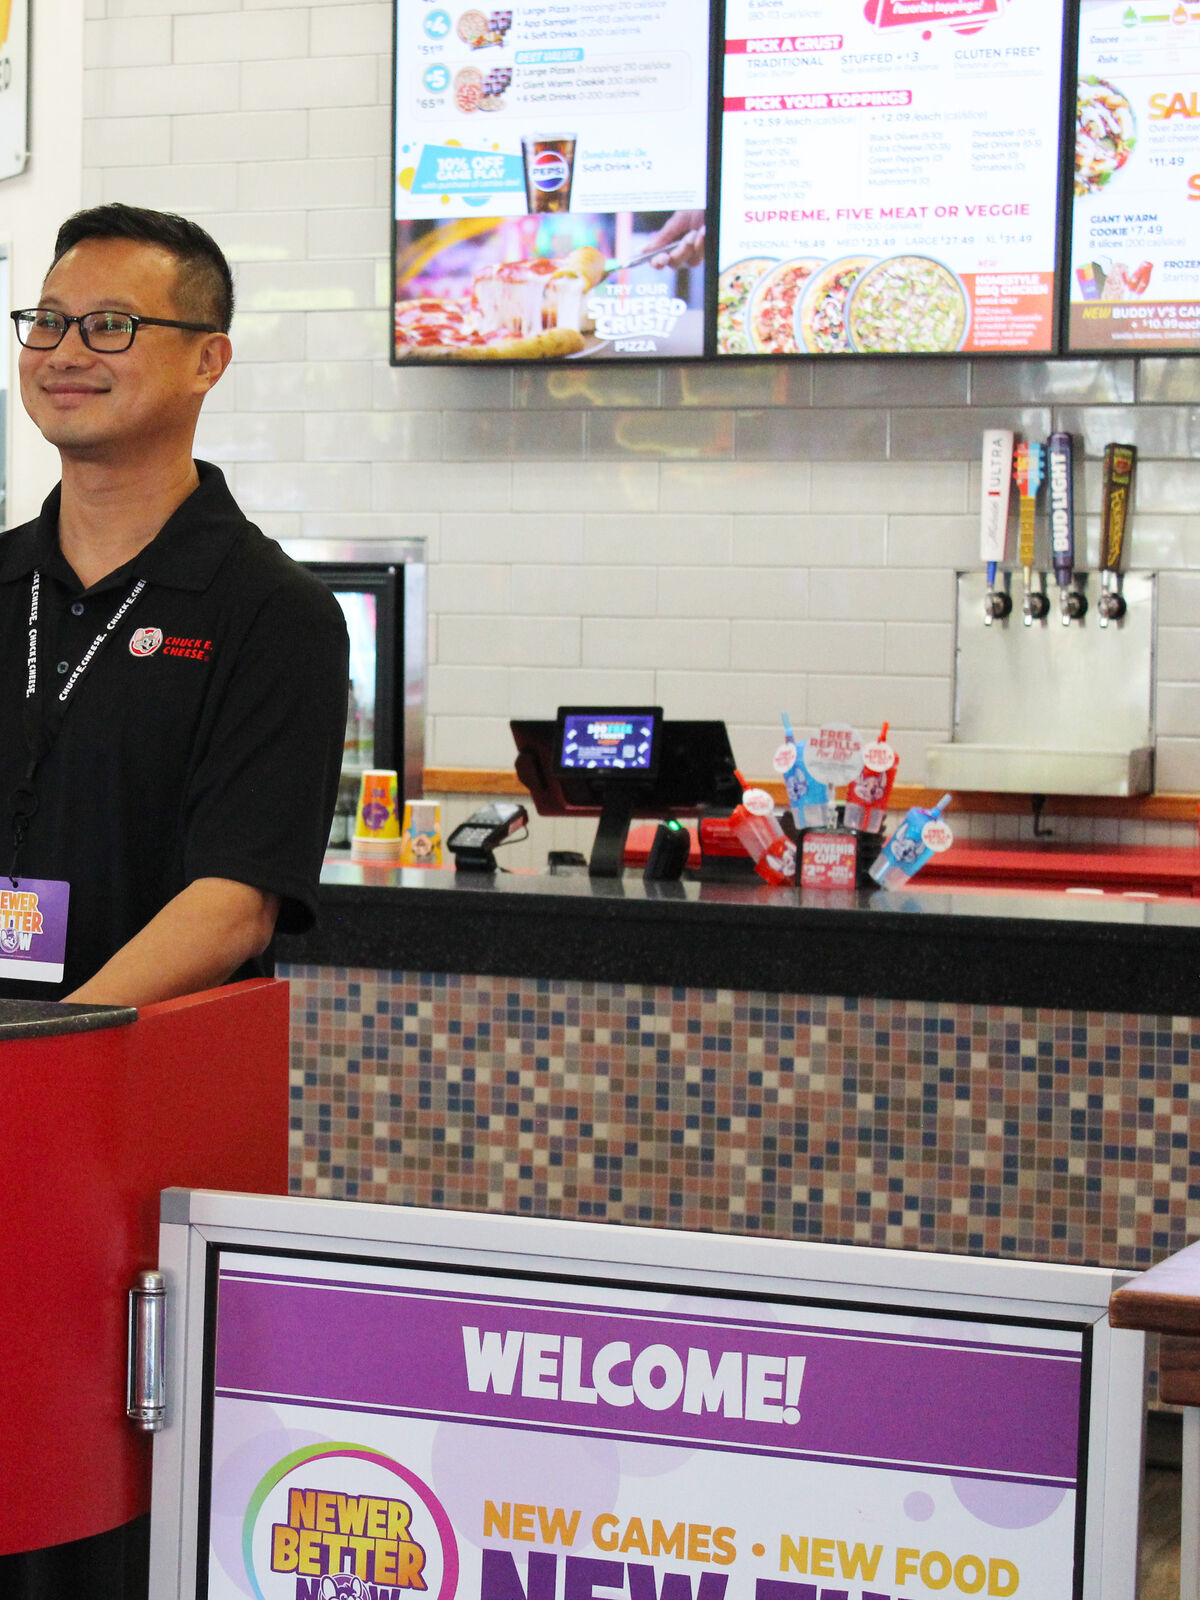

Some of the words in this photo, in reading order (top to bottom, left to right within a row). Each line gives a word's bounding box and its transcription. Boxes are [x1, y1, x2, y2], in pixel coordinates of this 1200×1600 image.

[746, 39, 780, 54] PICK
[794, 36, 843, 51] CRUST
[954, 48, 1001, 60] GLUTEN
[748, 56, 824, 68] TRADITIONAL
[841, 52, 893, 65] STUFFED
[745, 97, 781, 111] PICK
[783, 95, 828, 110] YOUR
[830, 92, 910, 108] TOPPINGS
[471, 156, 505, 170] OFF
[744, 209, 830, 224] SUPREME,
[837, 208, 874, 221] FIVE
[880, 206, 928, 220] MEAT
[935, 205, 960, 218] OR
[966, 204, 1031, 217] VEGGIE
[1090, 215, 1120, 224] GIANT
[1124, 214, 1158, 222] WARM
[1090, 228, 1128, 236] COOKIE
[635, 283, 668, 296] OUR
[587, 296, 688, 319] STUFFED
[1112, 306, 1155, 319] BUDDY
[990, 437, 1002, 488] ULTRA
[1051, 453, 1068, 509] LIGHT
[1054, 508, 1068, 551] BUD
[106, 602, 130, 630] CHUCK
[28, 628, 38, 659] CHUCK
[164, 636, 202, 648] CHUCK
[204, 640, 213, 650] E.
[58, 670, 80, 701] CHUCK
[820, 729, 852, 740] FREE
[810, 738, 861, 752] REFILLS
[461, 1325, 806, 1426] WELCOME!
[288, 1488, 414, 1541] NEWER
[271, 1523, 428, 1591] BETTER
[482, 1500, 582, 1547] NEW
[591, 1512, 738, 1566] GAMES
[779, 1534, 883, 1582] NEW
[896, 1547, 1020, 1598] FOOD
